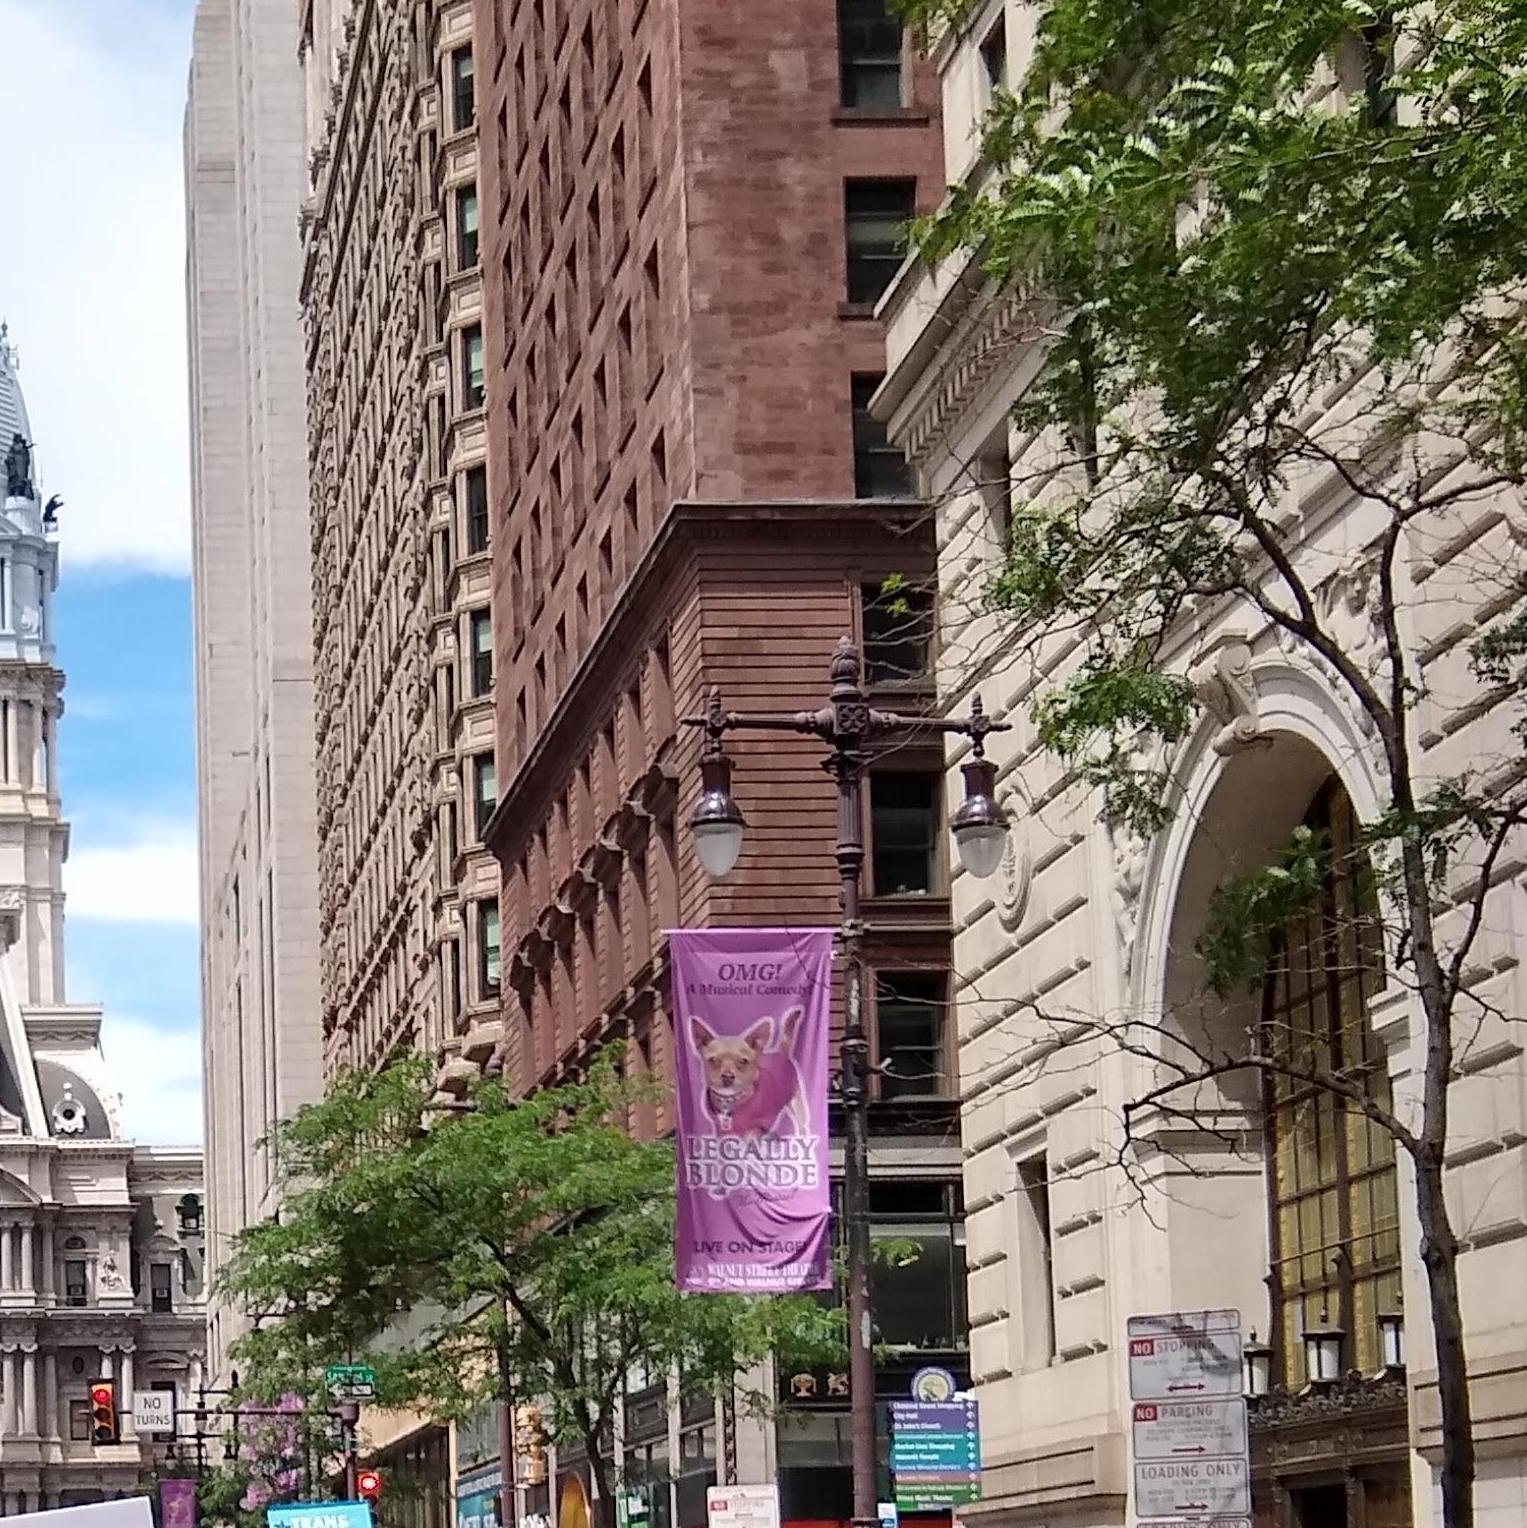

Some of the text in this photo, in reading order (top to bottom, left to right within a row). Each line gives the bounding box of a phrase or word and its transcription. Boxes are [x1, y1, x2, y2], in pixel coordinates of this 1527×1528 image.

[718, 963, 783, 982] OMG!
[686, 983, 695, 995] A
[698, 984, 753, 996] Musical
[688, 1137, 817, 1161] LEGALLY
[688, 1162, 817, 1187] BLONDE
[694, 1241, 723, 1254] LIVE
[728, 1241, 753, 1254] ON
[1133, 1344, 1151, 1355] NO
[143, 1397, 161, 1410] NO
[1136, 1405, 1214, 1419] NO PARKING
[136, 1414, 170, 1426] TURNS
[1141, 1463, 1240, 1480] LOADING ONLY
